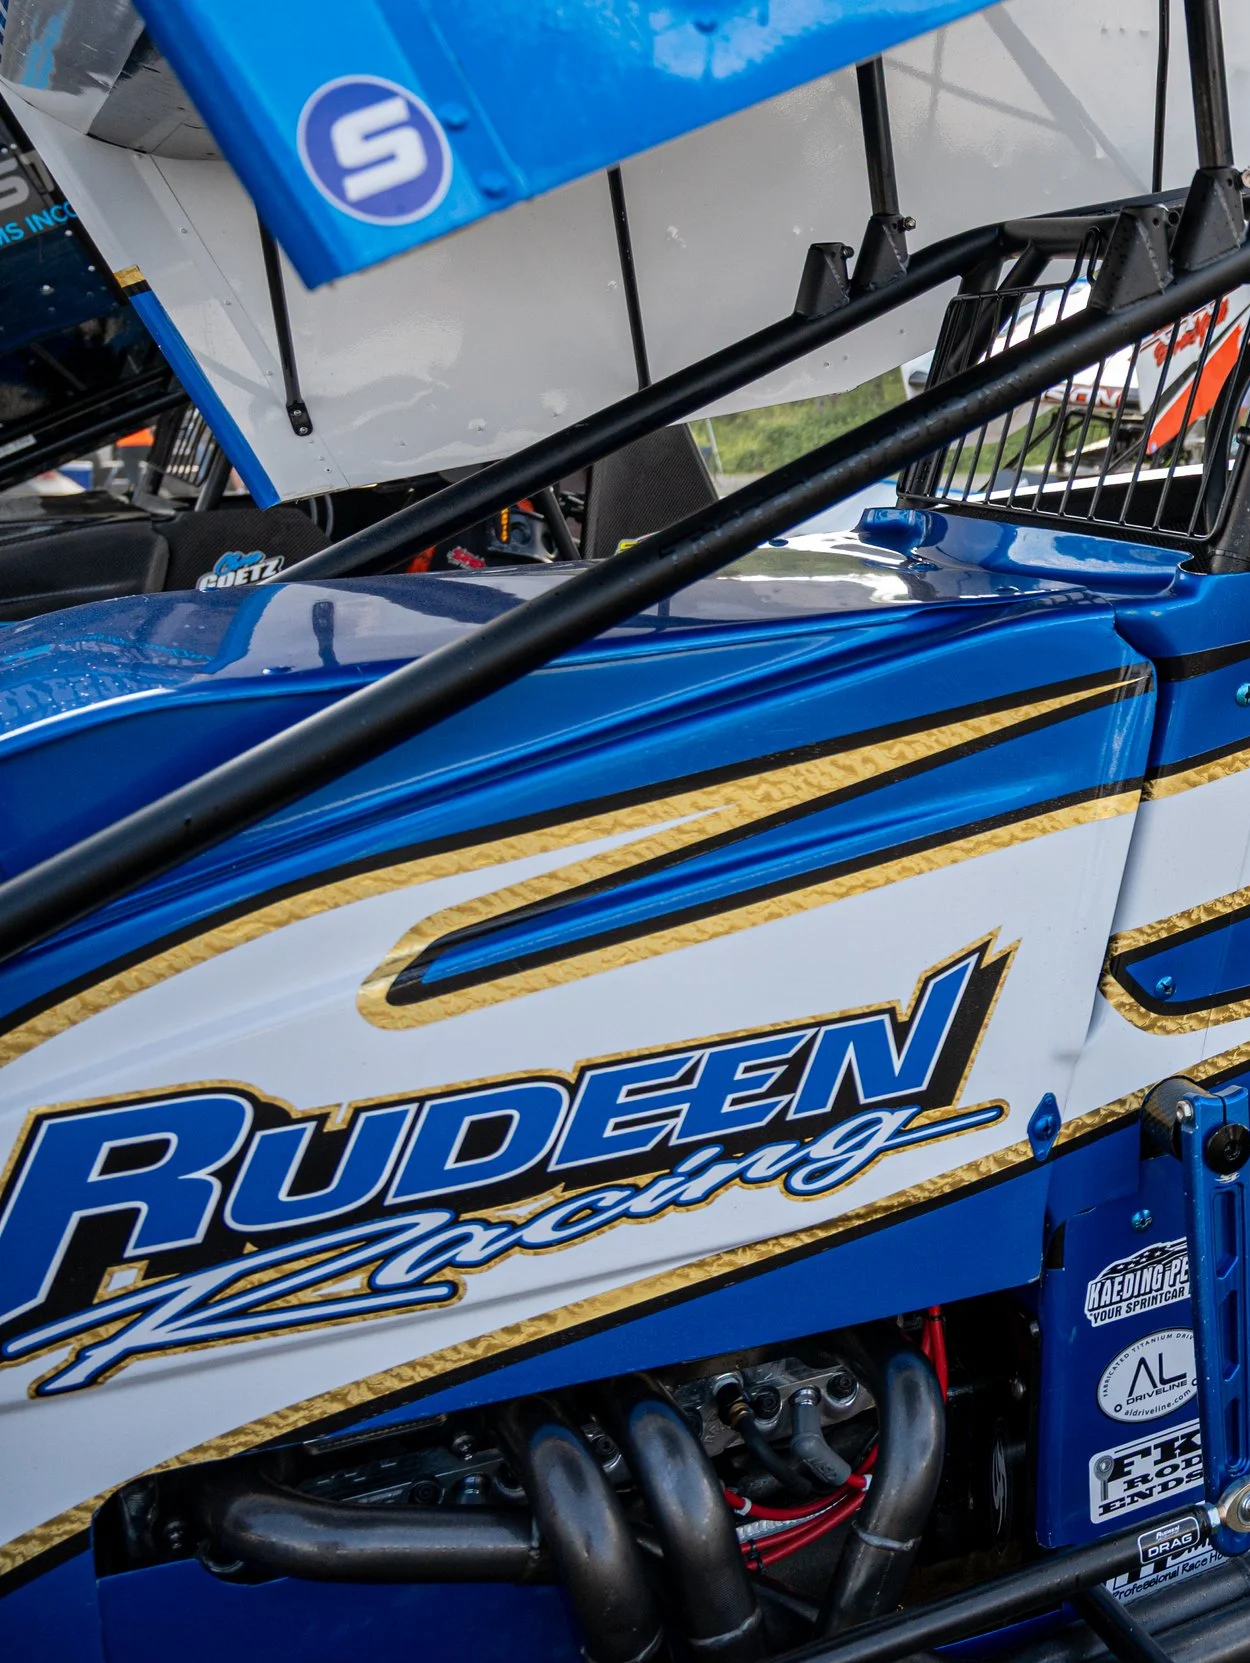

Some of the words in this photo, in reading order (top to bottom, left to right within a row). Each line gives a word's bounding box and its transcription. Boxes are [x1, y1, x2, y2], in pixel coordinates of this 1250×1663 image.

[0, 938, 1000, 1325] RUDEEN
[3, 1102, 1006, 1396] Racing
[1087, 1264, 1163, 1312] KAEDING
[1125, 1285, 1186, 1314] SPRINTCAR
[1102, 1353, 1130, 1398] FABRICATED
[1131, 1333, 1173, 1353] TITANIUM
[1124, 1388, 1192, 1417] aldriveline.com
[1126, 1379, 1188, 1406] DRIVELINE
[1098, 1469, 1205, 1517] ENDS
[1148, 1534, 1194, 1559] DRAG
[1181, 1559, 1209, 1576] Race
